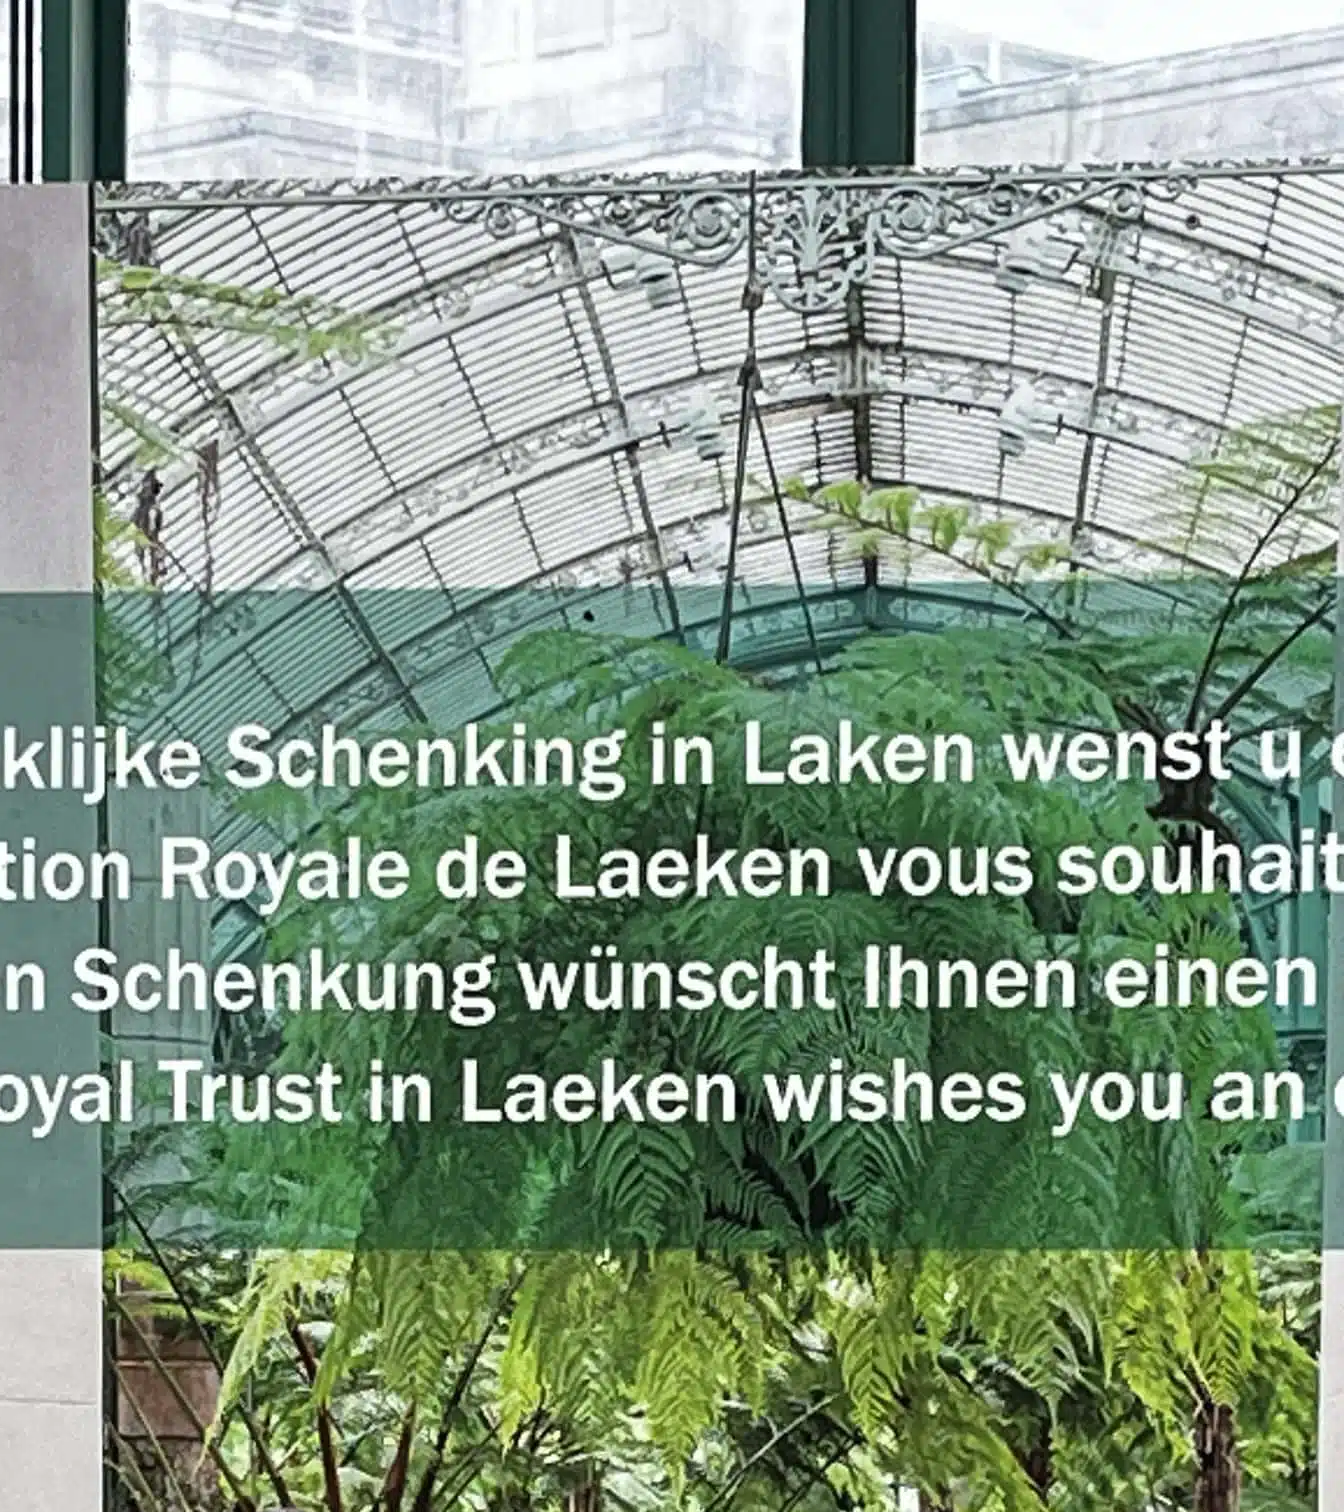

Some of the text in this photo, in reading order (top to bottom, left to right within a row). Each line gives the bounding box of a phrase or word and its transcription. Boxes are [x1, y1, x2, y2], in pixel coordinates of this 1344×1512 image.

[225, 722, 626, 801] Schenking
[652, 722, 713, 785] in
[745, 720, 973, 784] Laken
[1001, 719, 1231, 782] wenst
[1260, 730, 1301, 780] u
[161, 836, 410, 915] Royale
[436, 835, 527, 899] de
[556, 834, 829, 898] Laeken
[857, 846, 1034, 897] vous
[71, 947, 496, 1027] Schenkung
[517, 945, 836, 1011] wünscht
[865, 945, 1075, 1009] Ihnen
[1104, 943, 1316, 1008] einen
[157, 1059, 343, 1122] Trust
[370, 1060, 431, 1122] in
[463, 1058, 736, 1123] Laeken
[763, 1057, 1026, 1123] wishes
[1050, 1071, 1182, 1136] you
[1210, 1071, 1304, 1120] an
